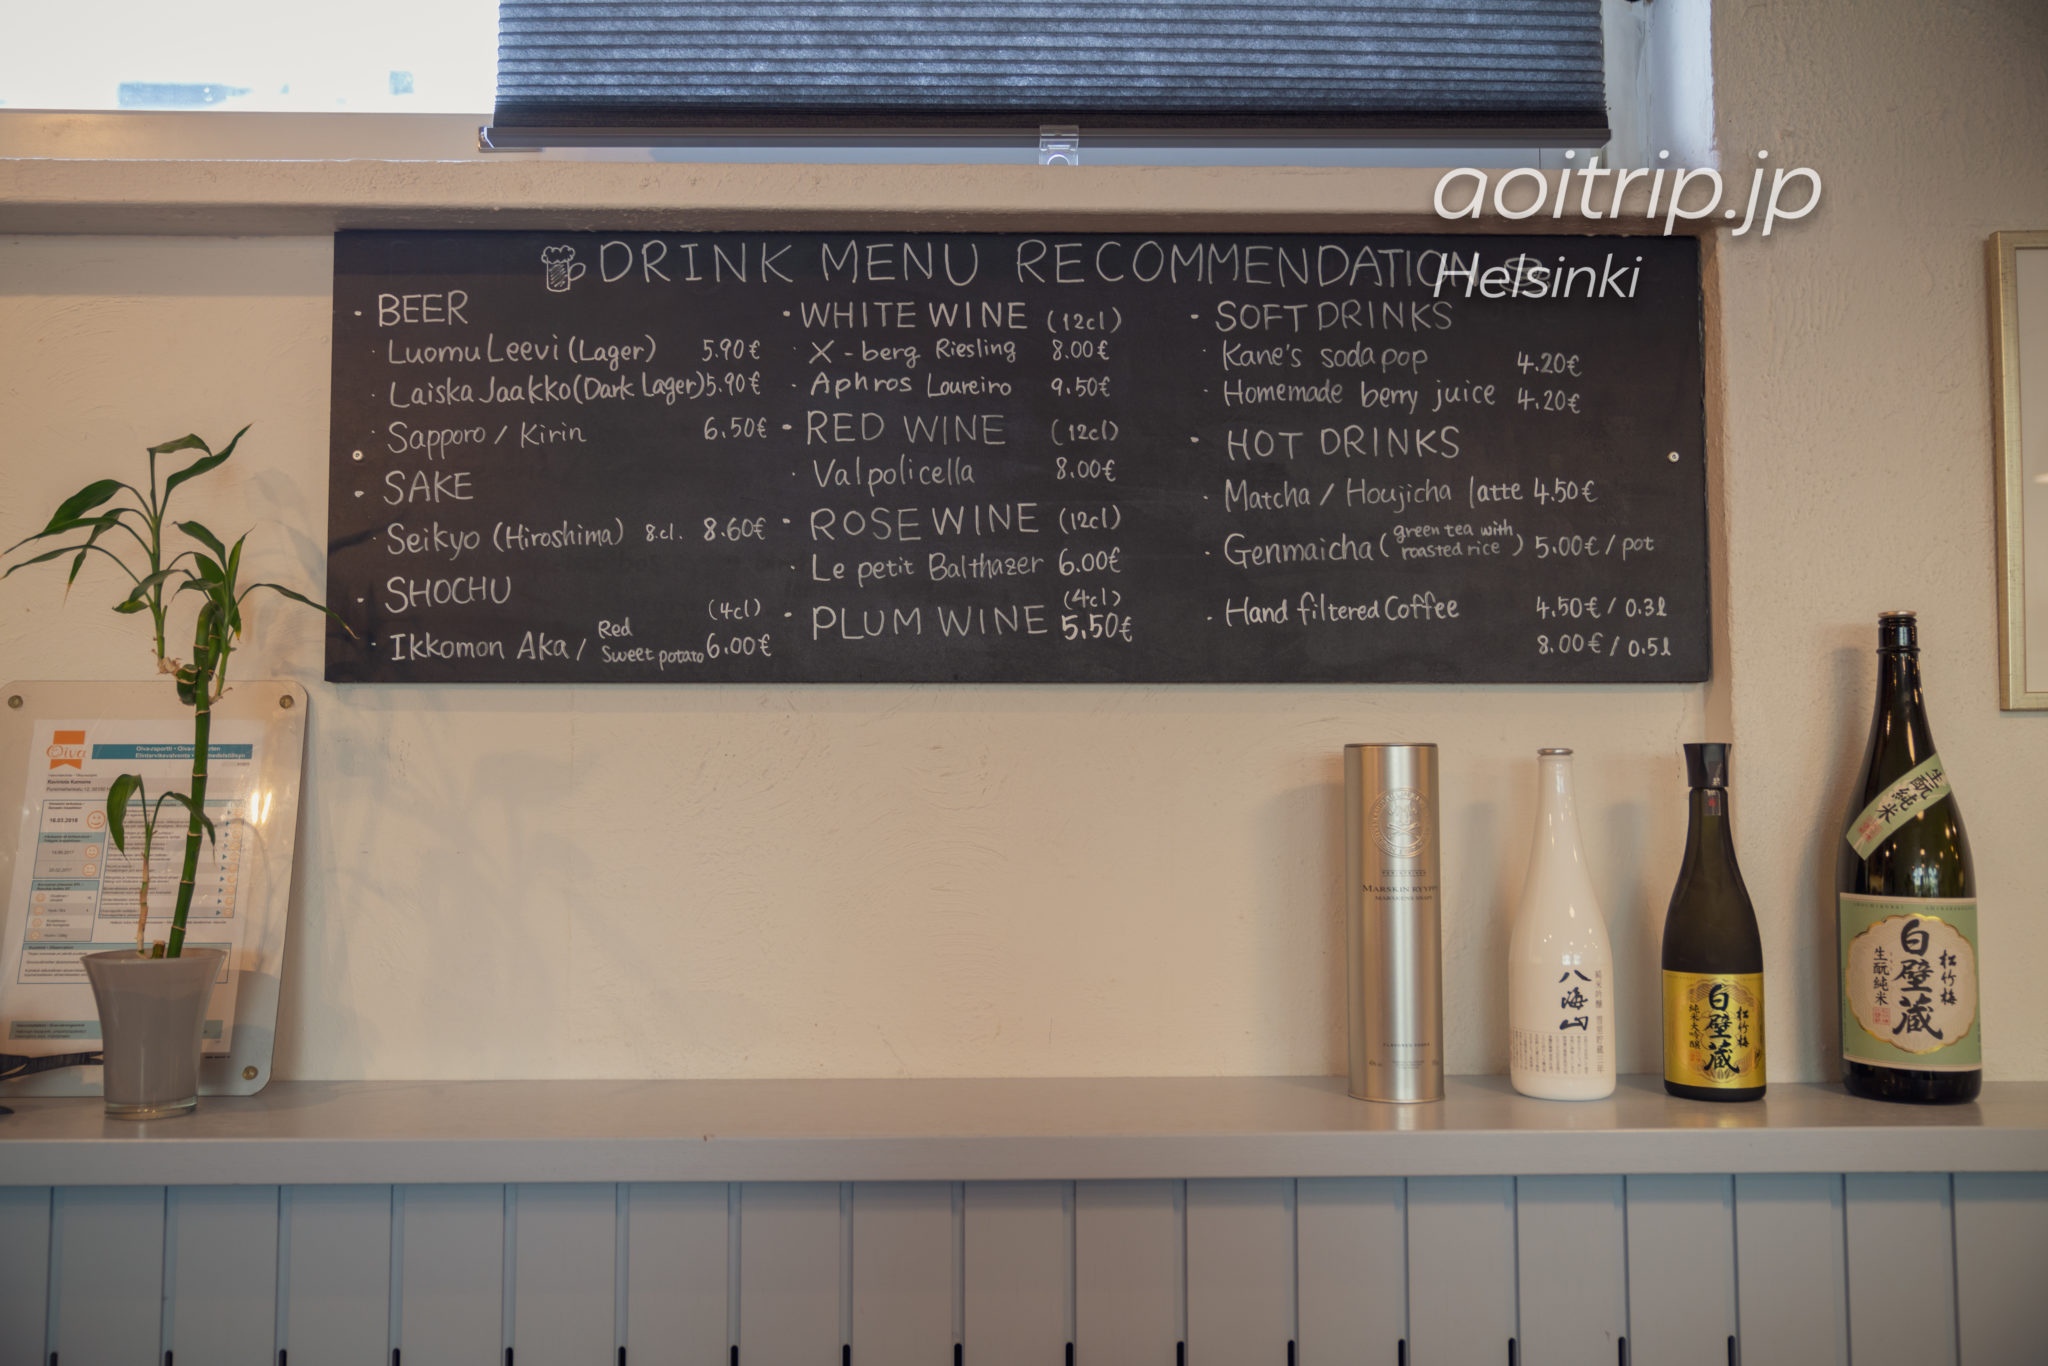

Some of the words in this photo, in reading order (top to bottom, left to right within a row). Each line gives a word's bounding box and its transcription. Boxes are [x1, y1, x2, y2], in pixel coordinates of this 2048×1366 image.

[599, 241, 795, 284] DRINK
[821, 240, 979, 286] MENU
[1016, 239, 1480, 290] RECOMMENDATION
[378, 290, 469, 327] BEER
[801, 302, 916, 329] WHITE
[929, 302, 1028, 329] WINE
[1215, 300, 1307, 332] SOFT
[1318, 300, 1453, 331] DRINKS
[388, 339, 481, 364] Luomu
[487, 333, 559, 362] Leevi
[569, 335, 656, 371] (Lager)
[702, 338, 761, 362] 5.90€
[936, 339, 1016, 363] Riesling
[1052, 339, 1110, 360] 8.00€
[1223, 340, 1302, 371] Kane's
[1321, 341, 1376, 367] soda
[1381, 349, 1428, 374] pop
[1517, 351, 1582, 377] 4.20€
[390, 381, 474, 407] Laiska
[573, 374, 635, 404] (Dark
[642, 371, 705, 405] Lager)
[705, 371, 761, 396] 5.90€
[811, 372, 912, 399] Aphros
[1051, 376, 1110, 397] 9.50€
[1224, 379, 1343, 406] Homemade
[1361, 381, 1418, 414] berry
[1432, 381, 1496, 412] juice
[1517, 389, 1581, 414] 4.20€
[388, 421, 485, 460] Sapporo
[521, 422, 587, 447] Kirin
[703, 416, 767, 440] 6.50€
[807, 410, 884, 444] RED
[904, 415, 1005, 446] WINE
[1228, 426, 1303, 461] HOT
[1320, 424, 1461, 460] DRINKS
[383, 471, 474, 505] SAKE
[813, 454, 975, 497] Valpolicella
[1056, 457, 1116, 482] 8.00€
[1224, 479, 1310, 512] Matcha
[1347, 478, 1452, 513] Houjicha
[1469, 476, 1523, 508] latte
[1533, 477, 1598, 503] 4.50€
[387, 522, 480, 560] Seikyo
[493, 517, 623, 552] (Hiroshima)
[703, 516, 767, 542] 8.60€
[810, 507, 921, 541] ROSE
[932, 503, 1039, 536] WINE
[1393, 524, 1440, 543] green
[1444, 524, 1474, 537] tea
[1480, 519, 1514, 537] with
[812, 554, 845, 581] Le
[858, 556, 914, 587] petit
[1058, 547, 1121, 575] 6.00€
[1402, 541, 1463, 558] roasted
[1467, 541, 1500, 555] rice
[1535, 537, 1600, 558] 5.00€
[1622, 537, 1655, 561] pot
[385, 576, 512, 614] SHOCHU
[1225, 596, 1288, 626] Hand
[1296, 591, 1380, 626] filtered
[1384, 591, 1460, 621] Coffee
[1536, 596, 1602, 619] 4.50€
[598, 618, 632, 638] Red
[812, 605, 921, 640] PLUM
[938, 605, 1048, 637] WINE
[1061, 613, 1133, 642] 5.50€
[390, 632, 505, 662] Ikkomon
[517, 632, 569, 660] Aka
[602, 645, 654, 664] Sweet
[659, 648, 704, 670] potato
[705, 632, 772, 660] 6.00€
[1537, 632, 1603, 655] 8.00€
[46, 744, 87, 759] Oiva
[1892, 918, 1944, 1041] 白壁蔵
[1558, 969, 1592, 1031] 八海山
[1703, 983, 1740, 1074] 白壁蔵
